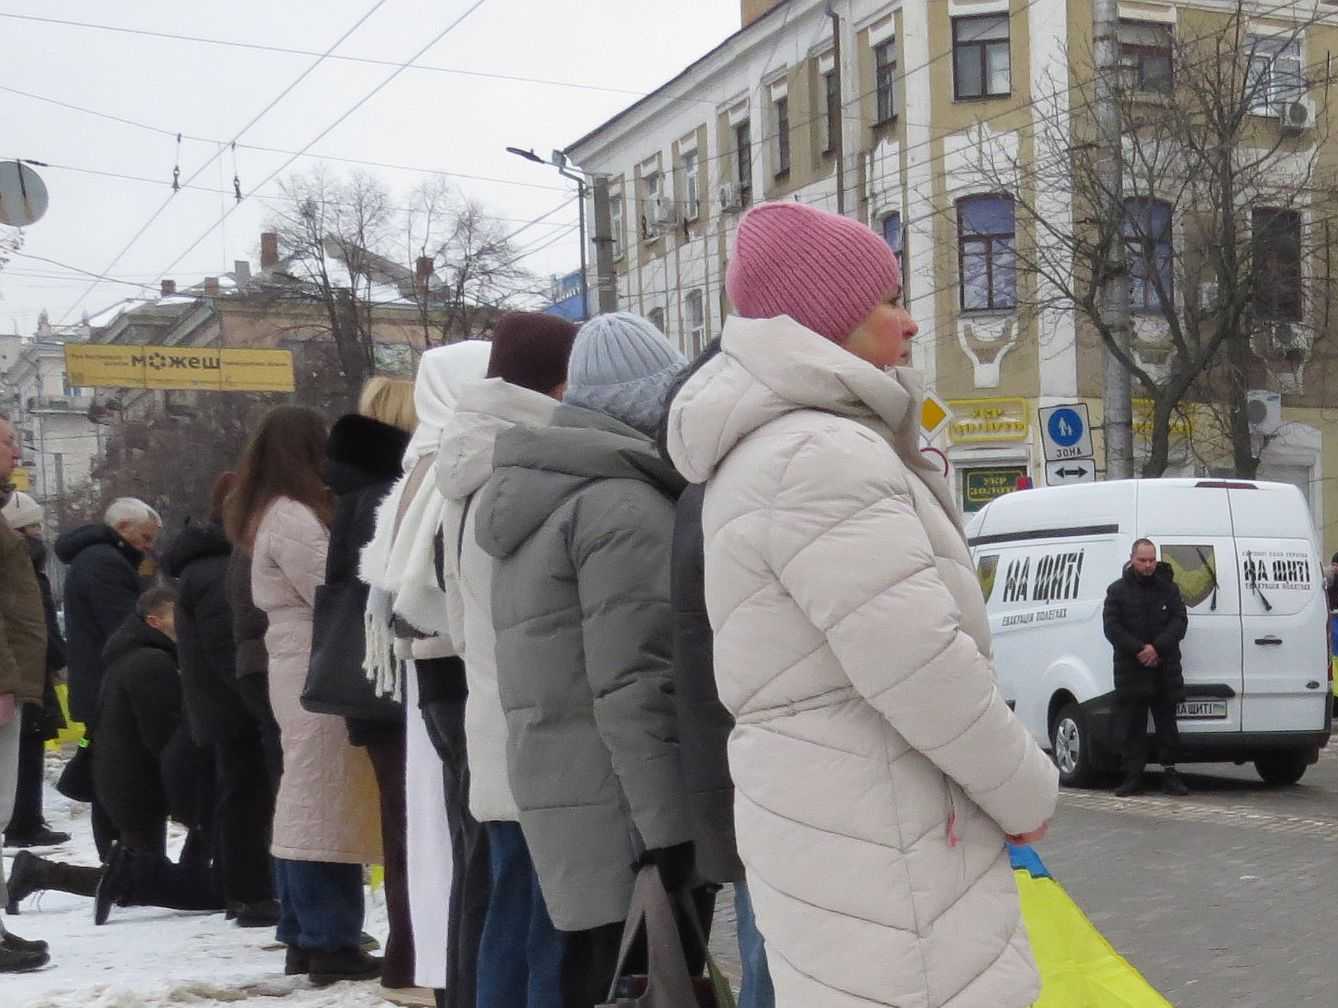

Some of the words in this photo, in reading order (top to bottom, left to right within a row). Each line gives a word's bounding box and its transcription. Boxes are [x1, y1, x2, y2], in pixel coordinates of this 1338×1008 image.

[1056, 447, 1082, 458] ЗОНА
[1003, 556, 1030, 602] НА
[1032, 547, 1085, 605] ЩИТІ
[1244, 559, 1269, 581] НА
[1272, 559, 1310, 584] ЩИТІ
